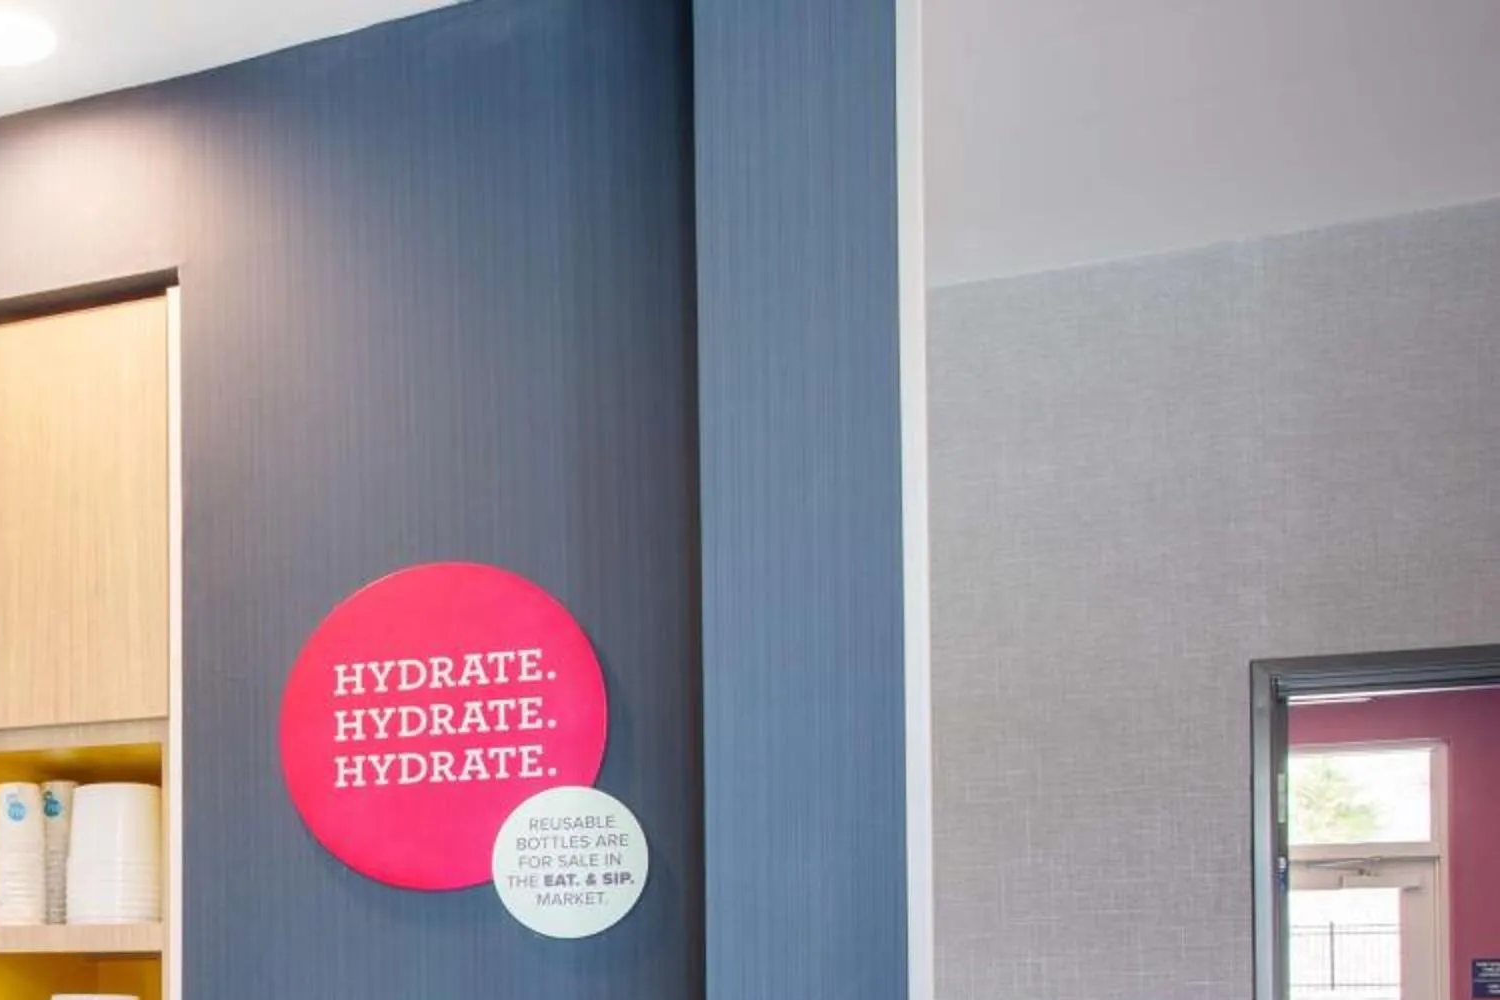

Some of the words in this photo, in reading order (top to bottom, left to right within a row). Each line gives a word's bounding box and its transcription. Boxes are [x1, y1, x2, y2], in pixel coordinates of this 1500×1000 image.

[333, 648, 557, 696] HYDRATE.
[333, 696, 557, 742] HYDRATE.
[334, 744, 557, 788] HYDRATE.
[529, 815, 617, 831] REUSABLE
[516, 835, 591, 851] BOTTLES
[595, 833, 629, 848] ARE
[518, 855, 552, 869] FOR
[558, 853, 599, 868] SALE
[605, 851, 622, 866] IN
[507, 874, 540, 889] THE
[543, 873, 580, 888] EAT.
[585, 872, 597, 886] &
[602, 871, 635, 886] SIP.
